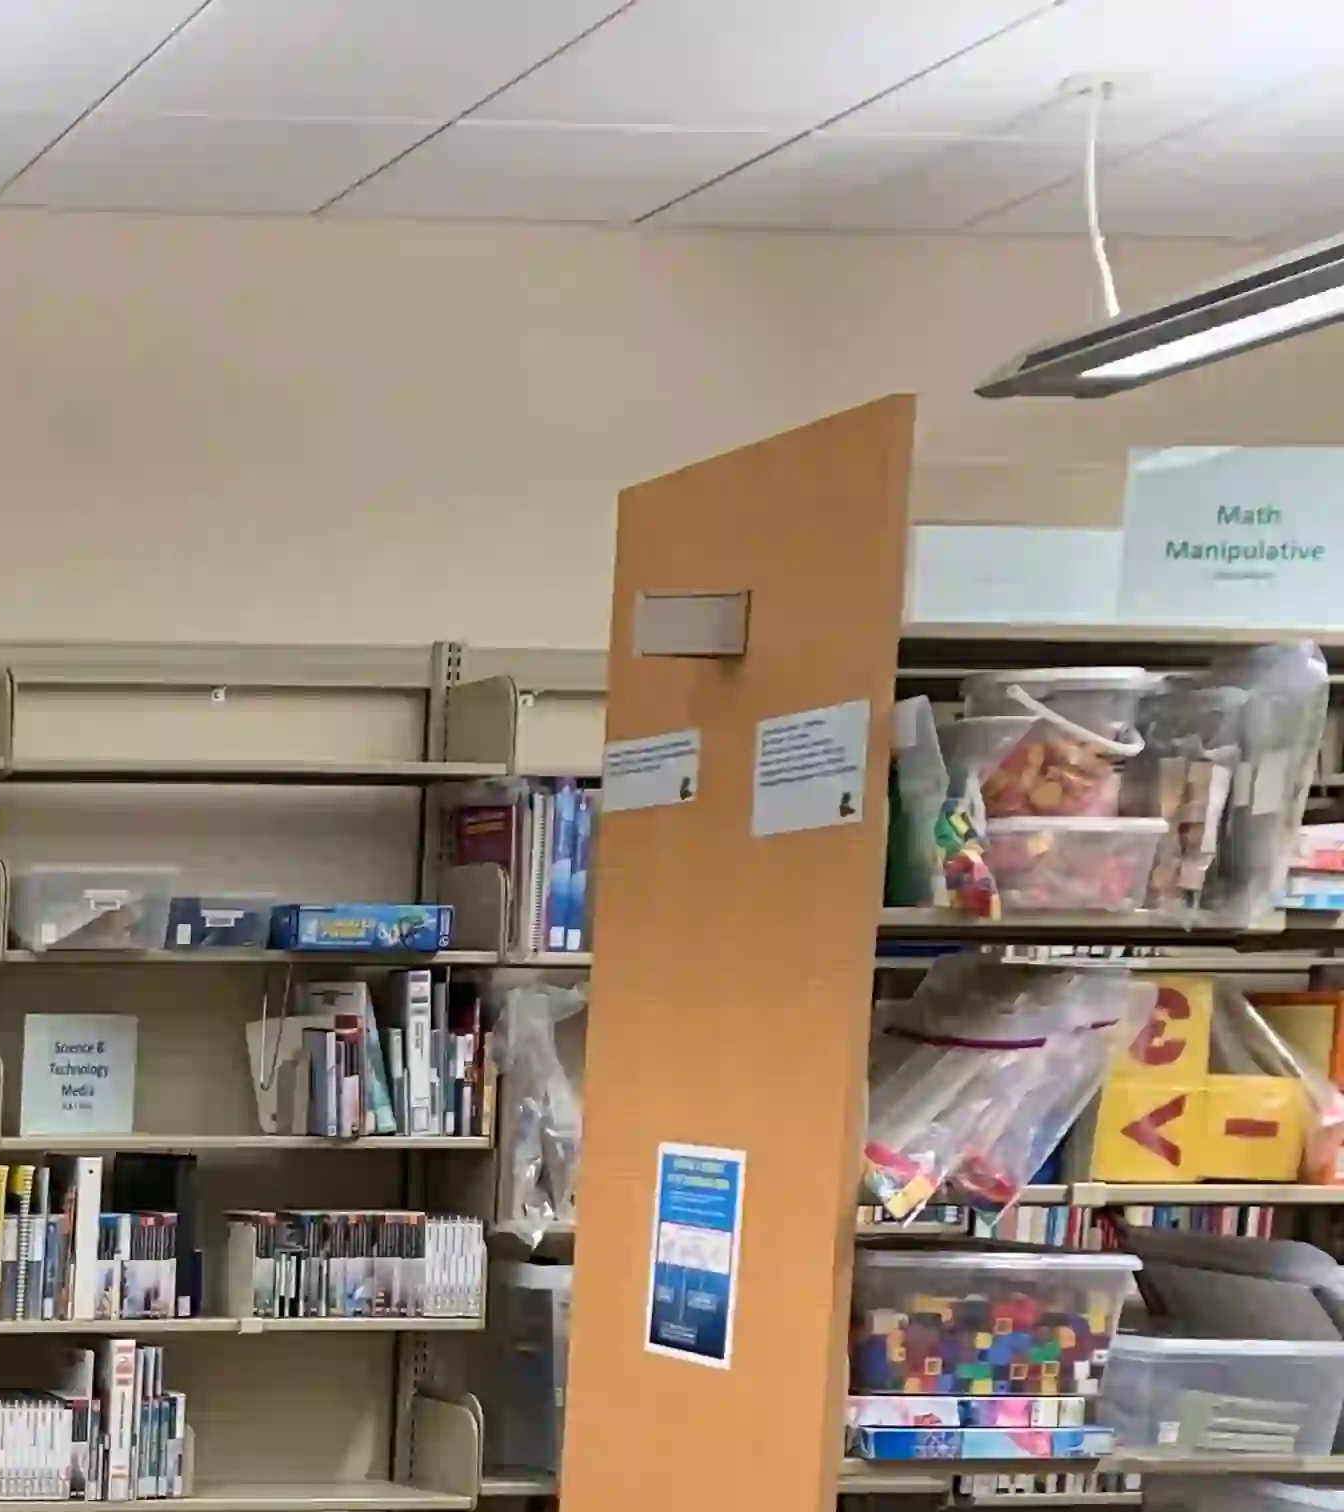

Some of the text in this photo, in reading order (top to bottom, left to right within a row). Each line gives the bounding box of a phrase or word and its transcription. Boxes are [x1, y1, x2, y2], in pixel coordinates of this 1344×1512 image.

[1217, 504, 1282, 525] Math
[1165, 540, 1326, 564] Manipulative
[55, 1042, 94, 1053] Science
[49, 1061, 108, 1078] Technology
[61, 1084, 95, 1097] Media
